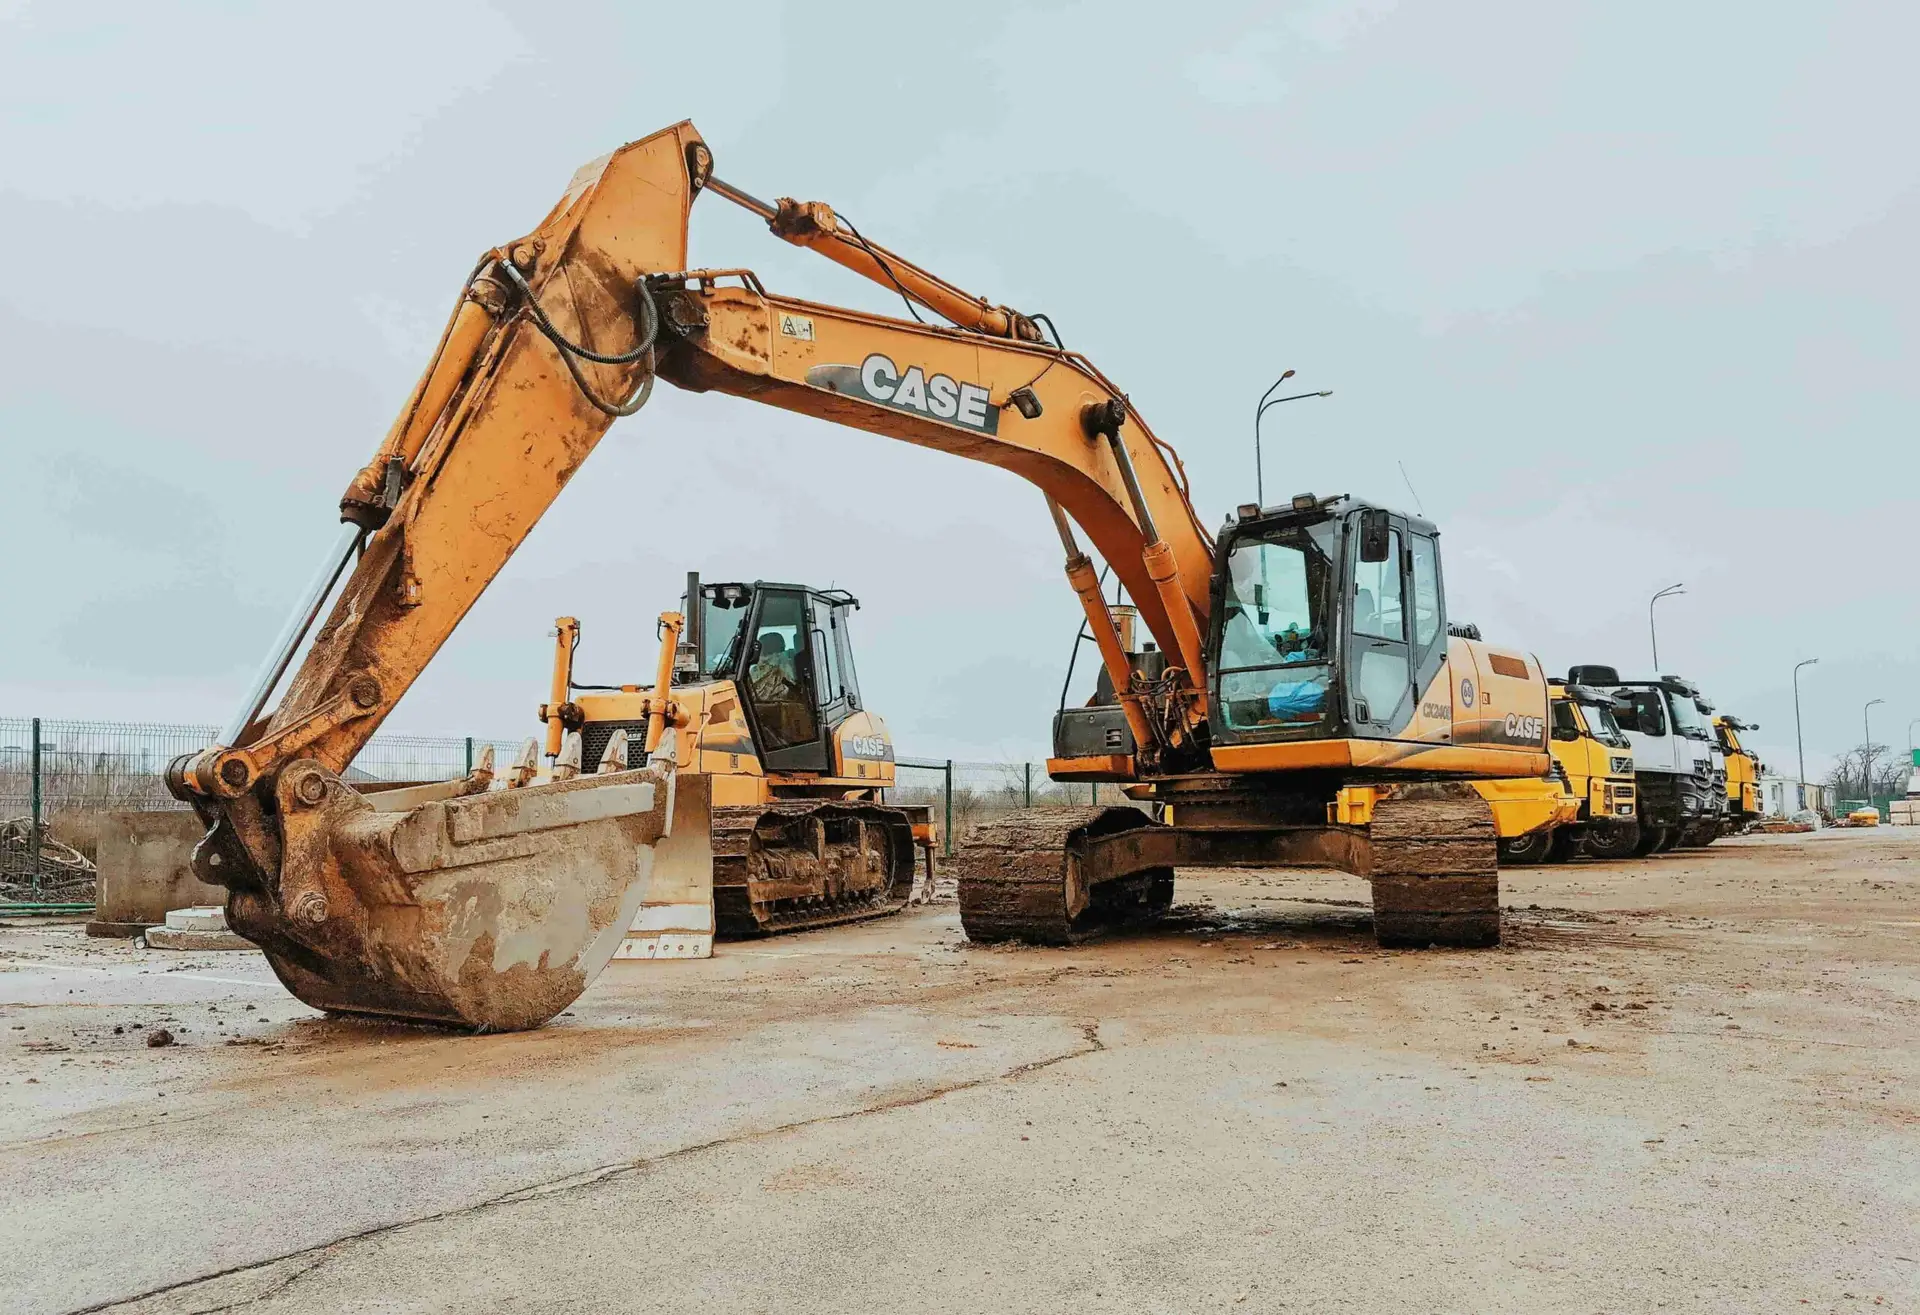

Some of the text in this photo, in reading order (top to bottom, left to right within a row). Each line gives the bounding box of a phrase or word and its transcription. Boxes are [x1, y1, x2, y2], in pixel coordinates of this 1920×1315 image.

[861, 354, 989, 427] CASE
[1504, 713, 1542, 739] CASE
[852, 734, 884, 756] CASE
